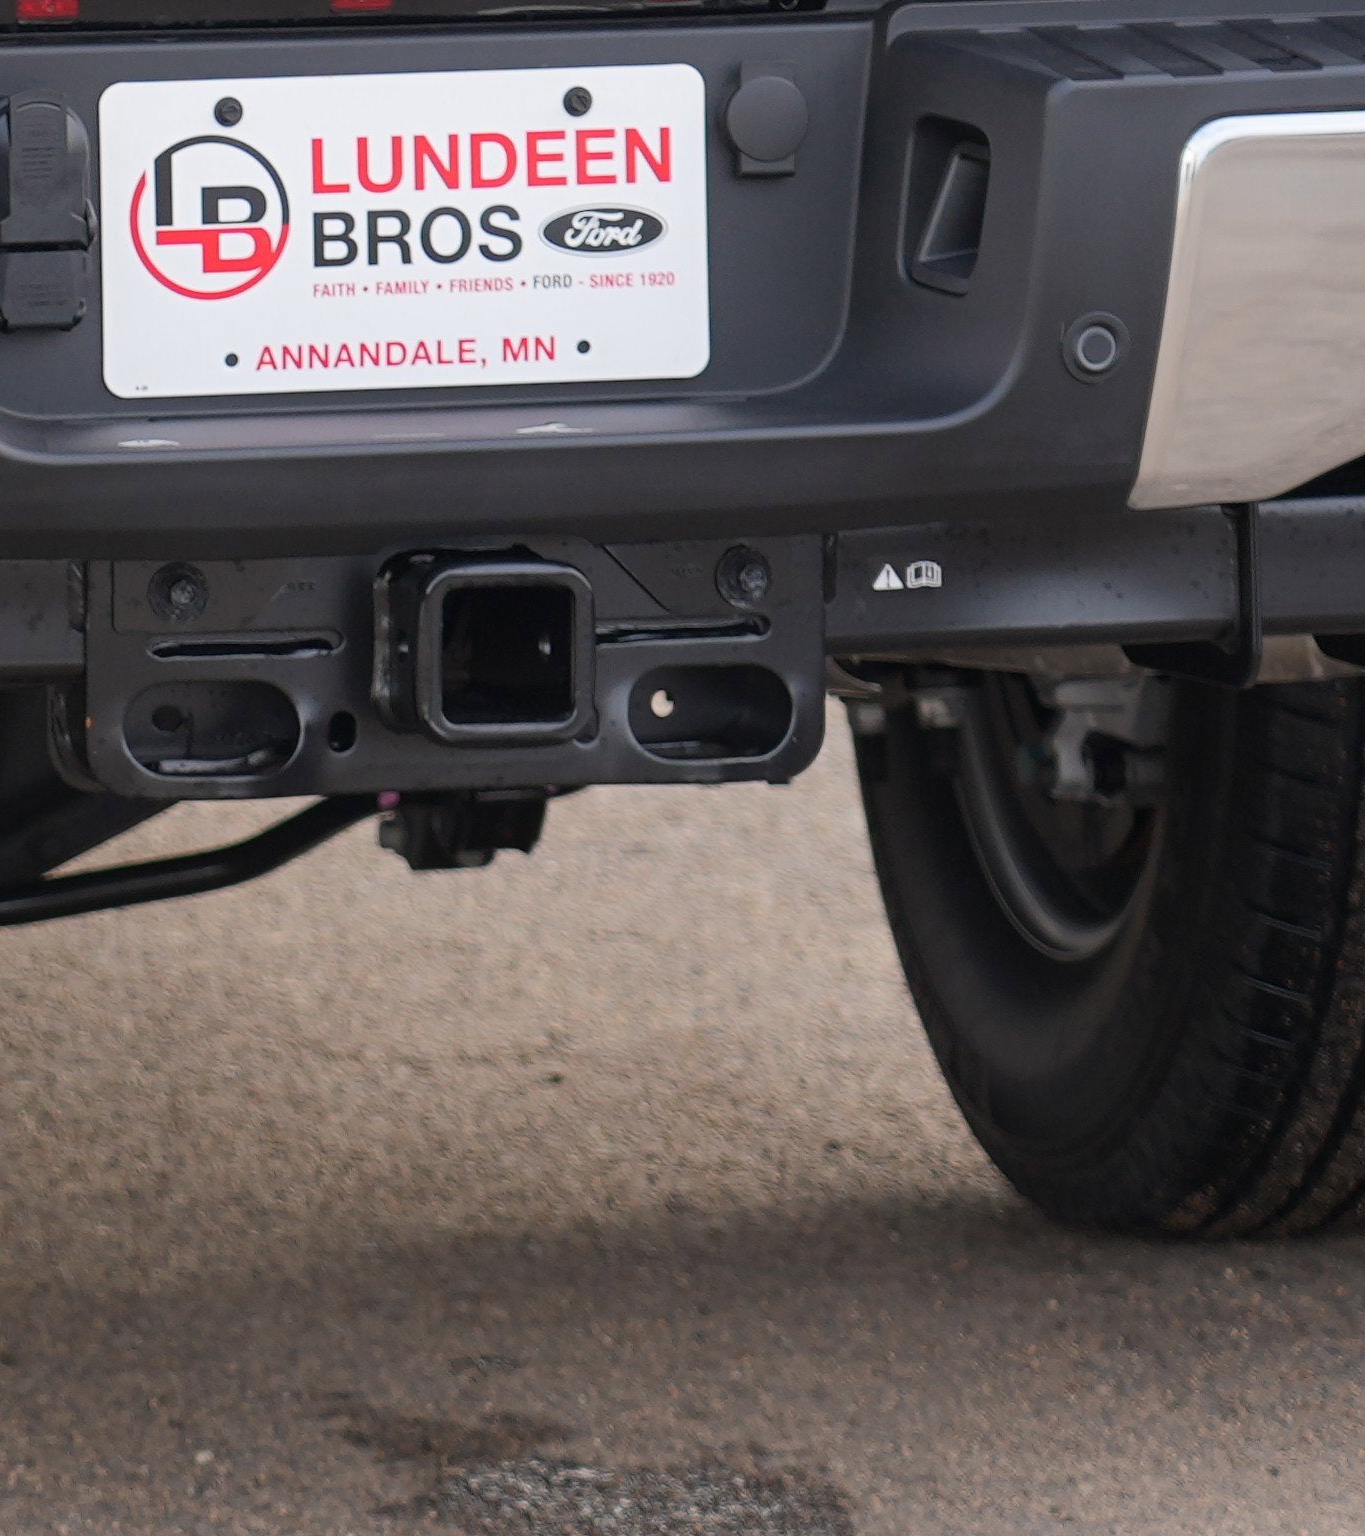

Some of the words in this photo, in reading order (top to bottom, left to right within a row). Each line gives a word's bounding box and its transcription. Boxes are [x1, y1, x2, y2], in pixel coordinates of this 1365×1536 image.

[310, 126, 672, 195] LUNDEEN
[312, 204, 523, 268] BROS
[313, 282, 357, 298] FAITH
[375, 280, 430, 296] FAMILY
[449, 277, 514, 293] FRIENDS
[532, 273, 573, 289] FORD
[588, 272, 635, 289] SINCE
[639, 271, 676, 287] 1920
[255, 337, 488, 372] ANNANDALE,
[501, 335, 557, 363] MN
